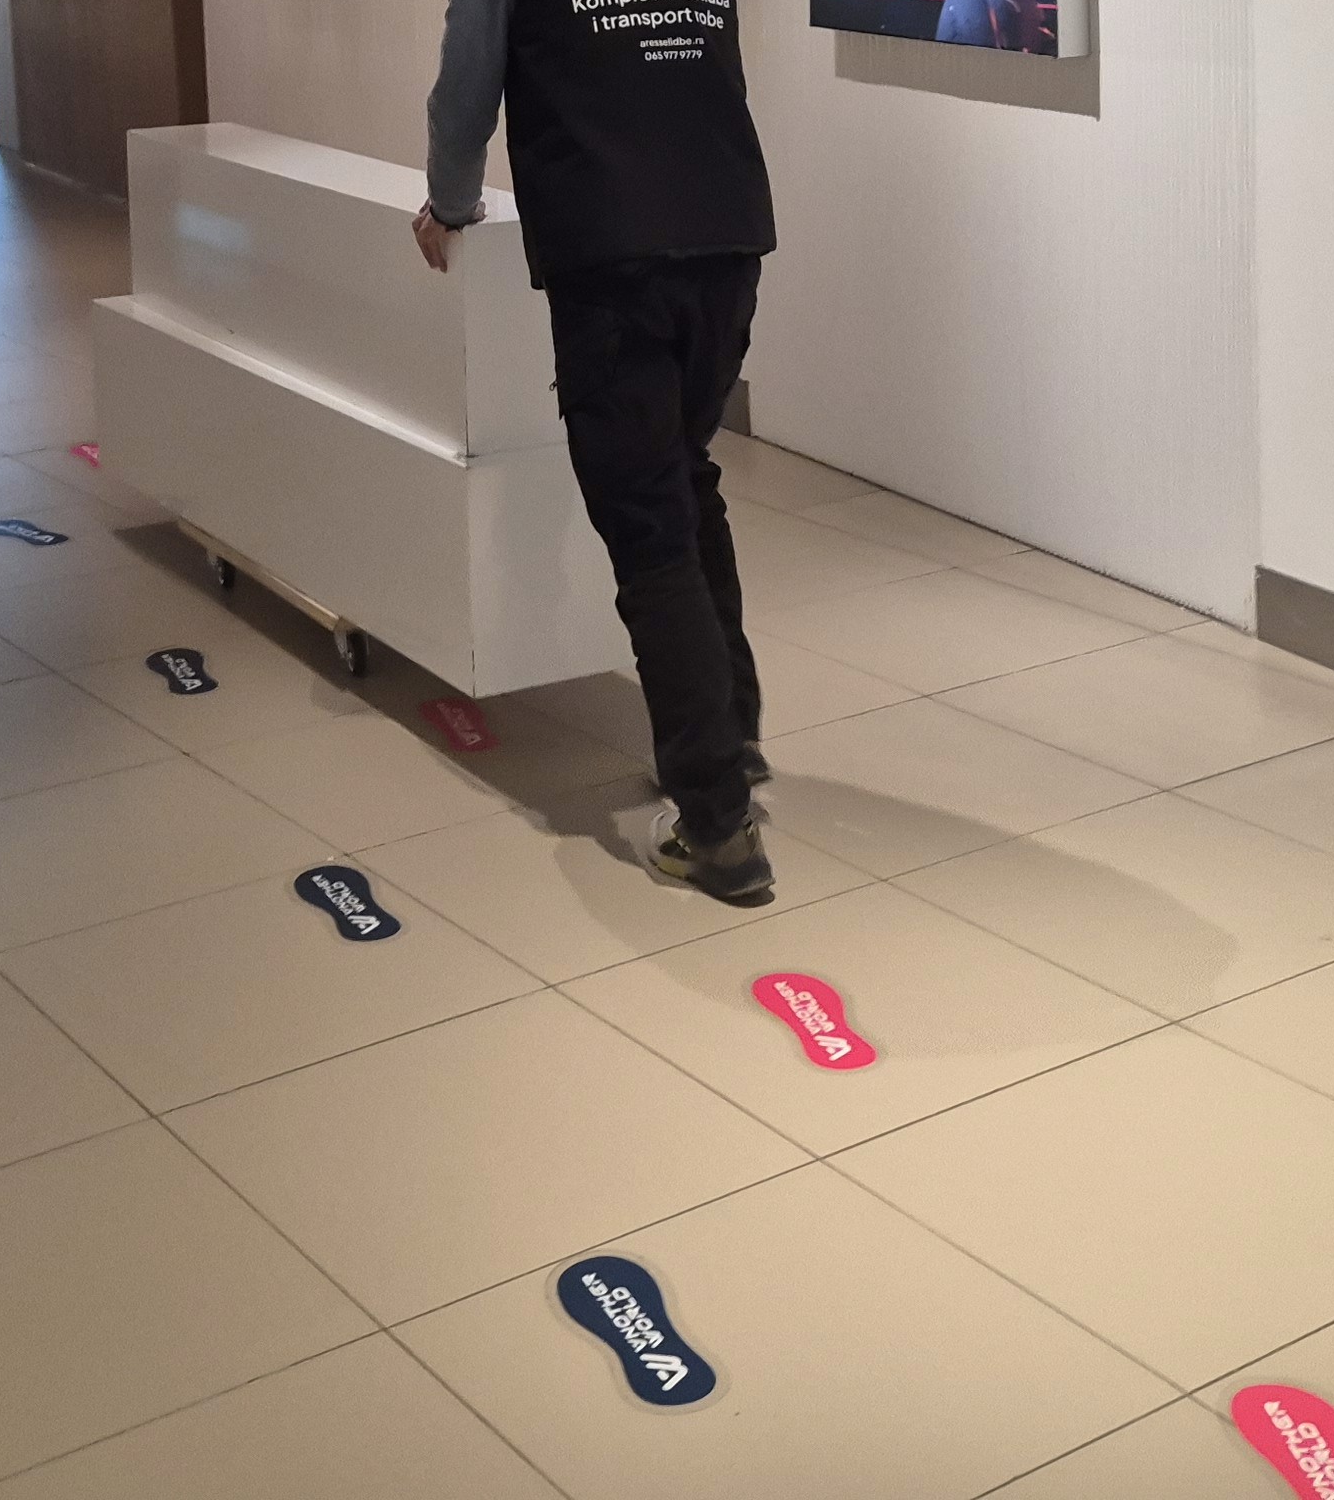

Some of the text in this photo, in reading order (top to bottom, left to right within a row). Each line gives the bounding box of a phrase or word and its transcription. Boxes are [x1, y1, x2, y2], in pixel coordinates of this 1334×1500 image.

[592, 7, 724, 33] i transport robe
